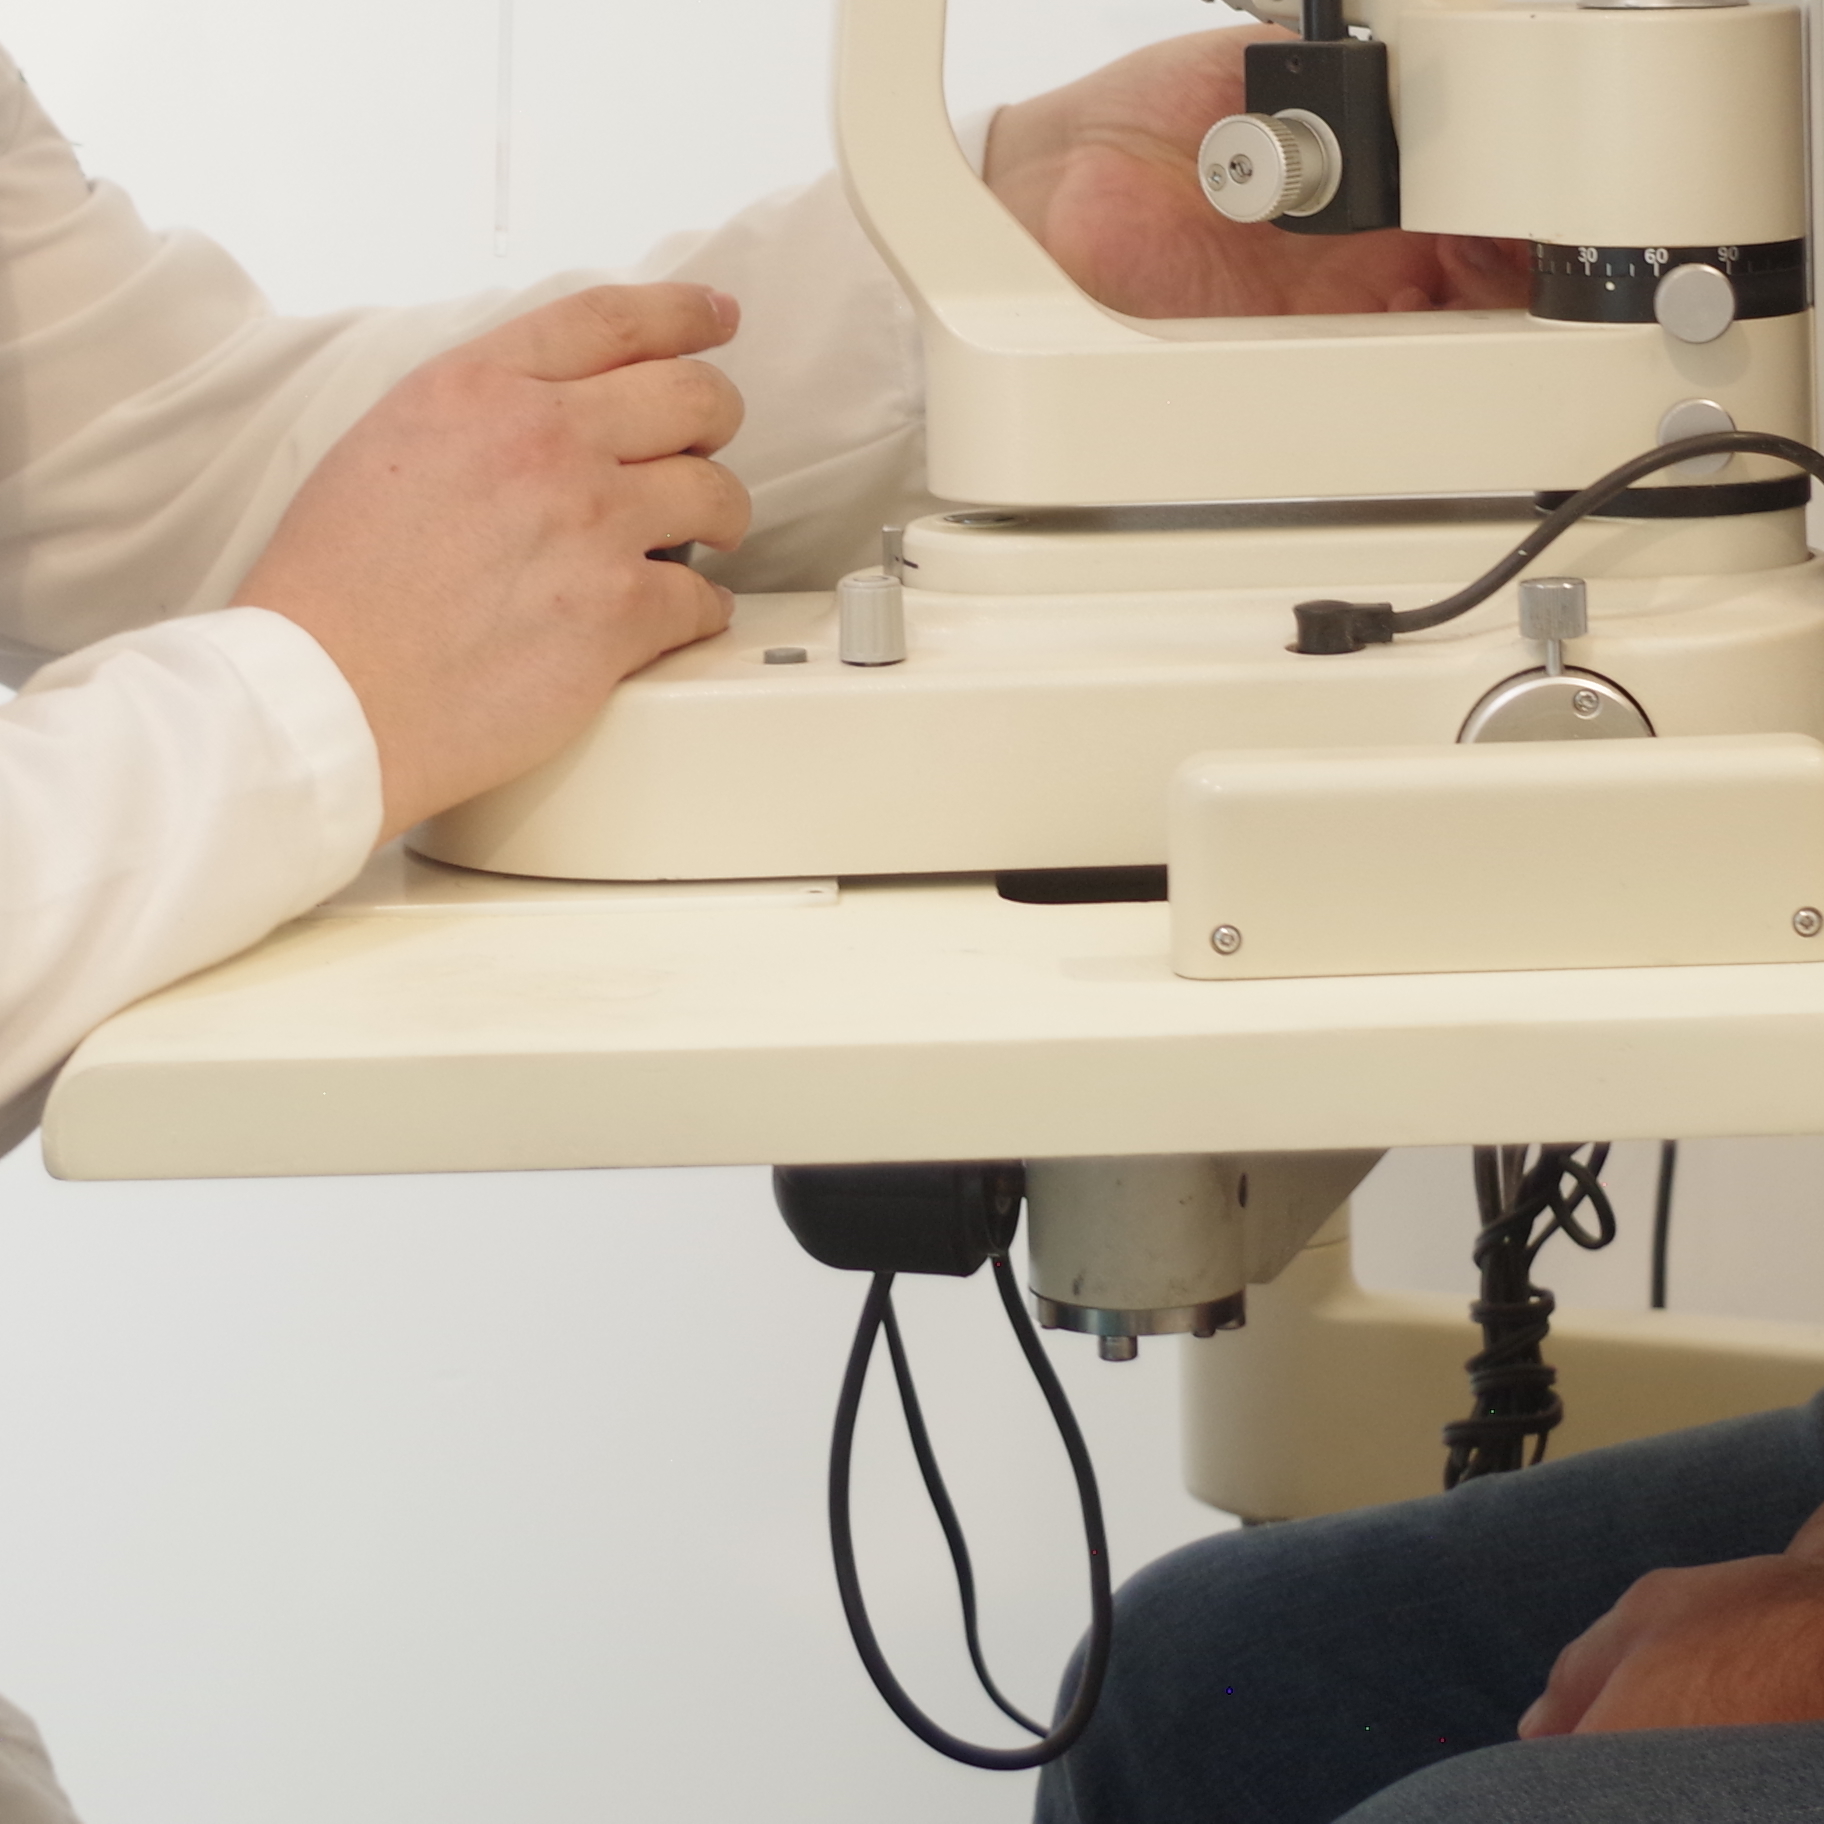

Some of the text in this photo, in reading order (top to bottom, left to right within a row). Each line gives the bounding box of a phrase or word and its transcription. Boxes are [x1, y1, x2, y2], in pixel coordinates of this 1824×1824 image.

[1578, 247, 1598, 263] 30
[1644, 248, 1669, 264] 60
[1718, 246, 1739, 262] 90
